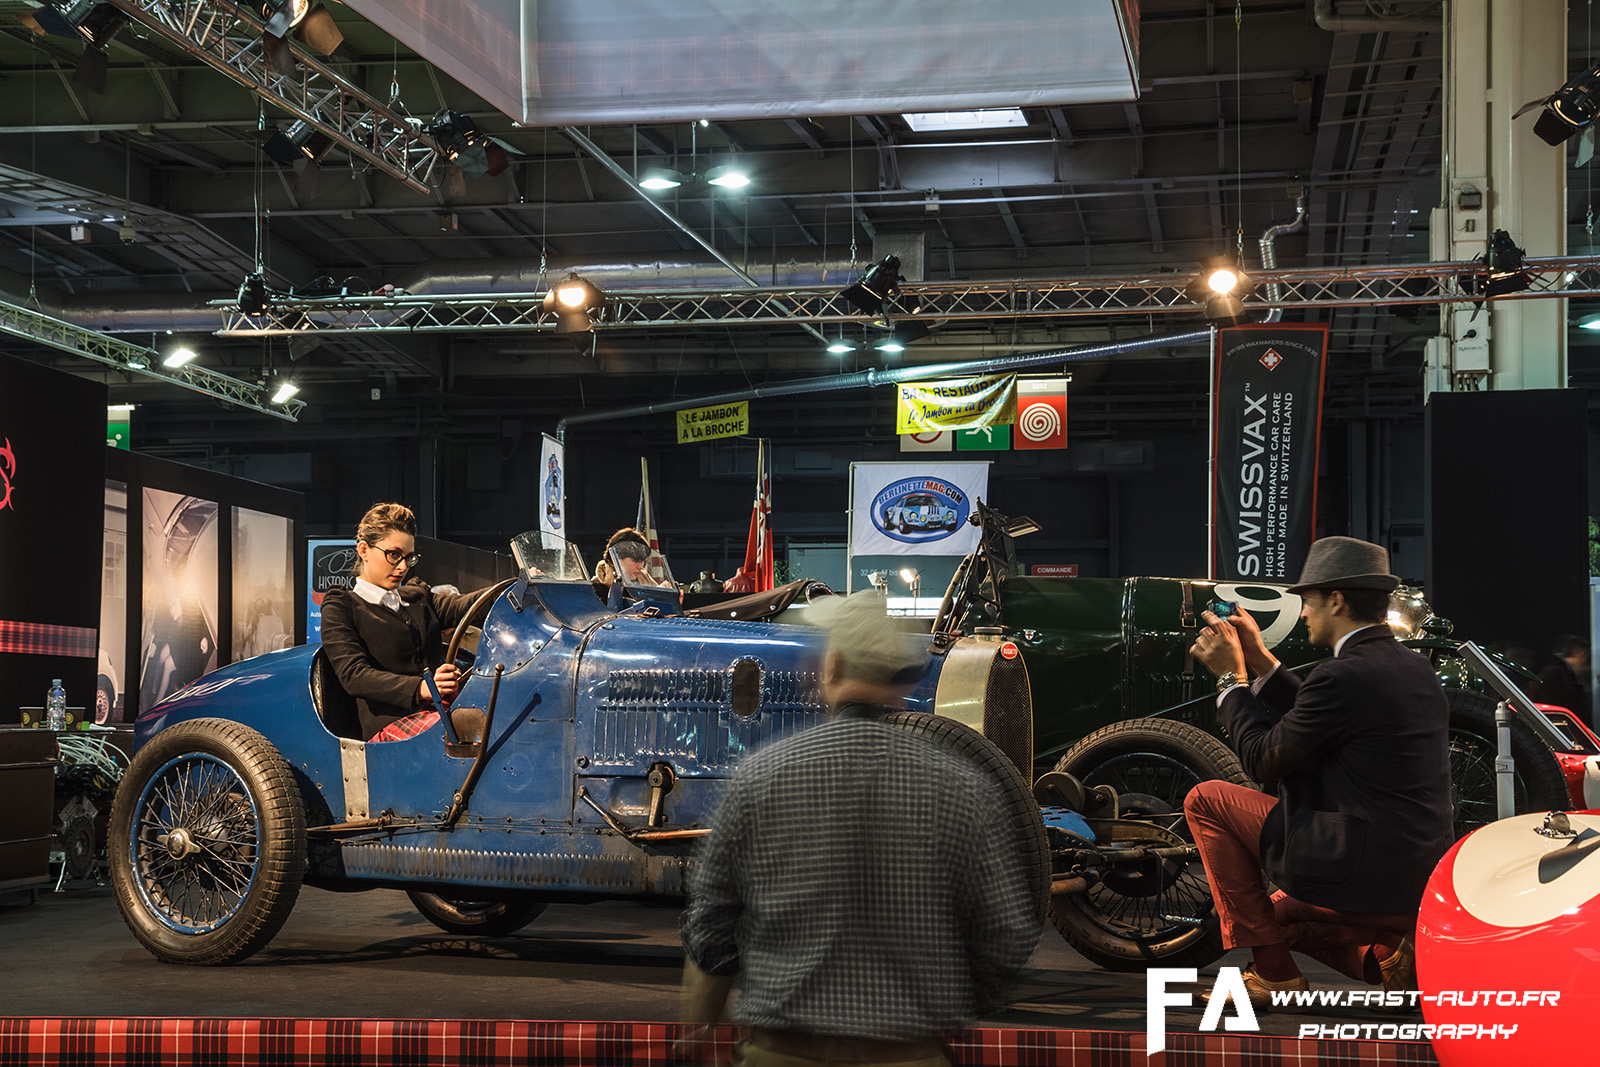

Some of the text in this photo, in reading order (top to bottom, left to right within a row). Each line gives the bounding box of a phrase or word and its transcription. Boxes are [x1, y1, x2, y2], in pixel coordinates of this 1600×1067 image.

[1226, 344, 1246, 357] SWISS
[1246, 339, 1284, 348] WAXMAKERS
[1284, 340, 1303, 350] SINCE
[685, 406, 739, 424] LE JAMBON
[920, 404, 952, 422] Jambon
[691, 427, 703, 438] LA
[705, 420, 744, 436] BROCHE
[878, 481, 964, 505] BERLINETTEMAG.COM
[1237, 393, 1267, 577] SWISSVAX
[1265, 392, 1282, 577] HIGH PERFORMANCE CAR CARE
[1277, 392, 1293, 578] HAND MADE IN SWITZERLAND
